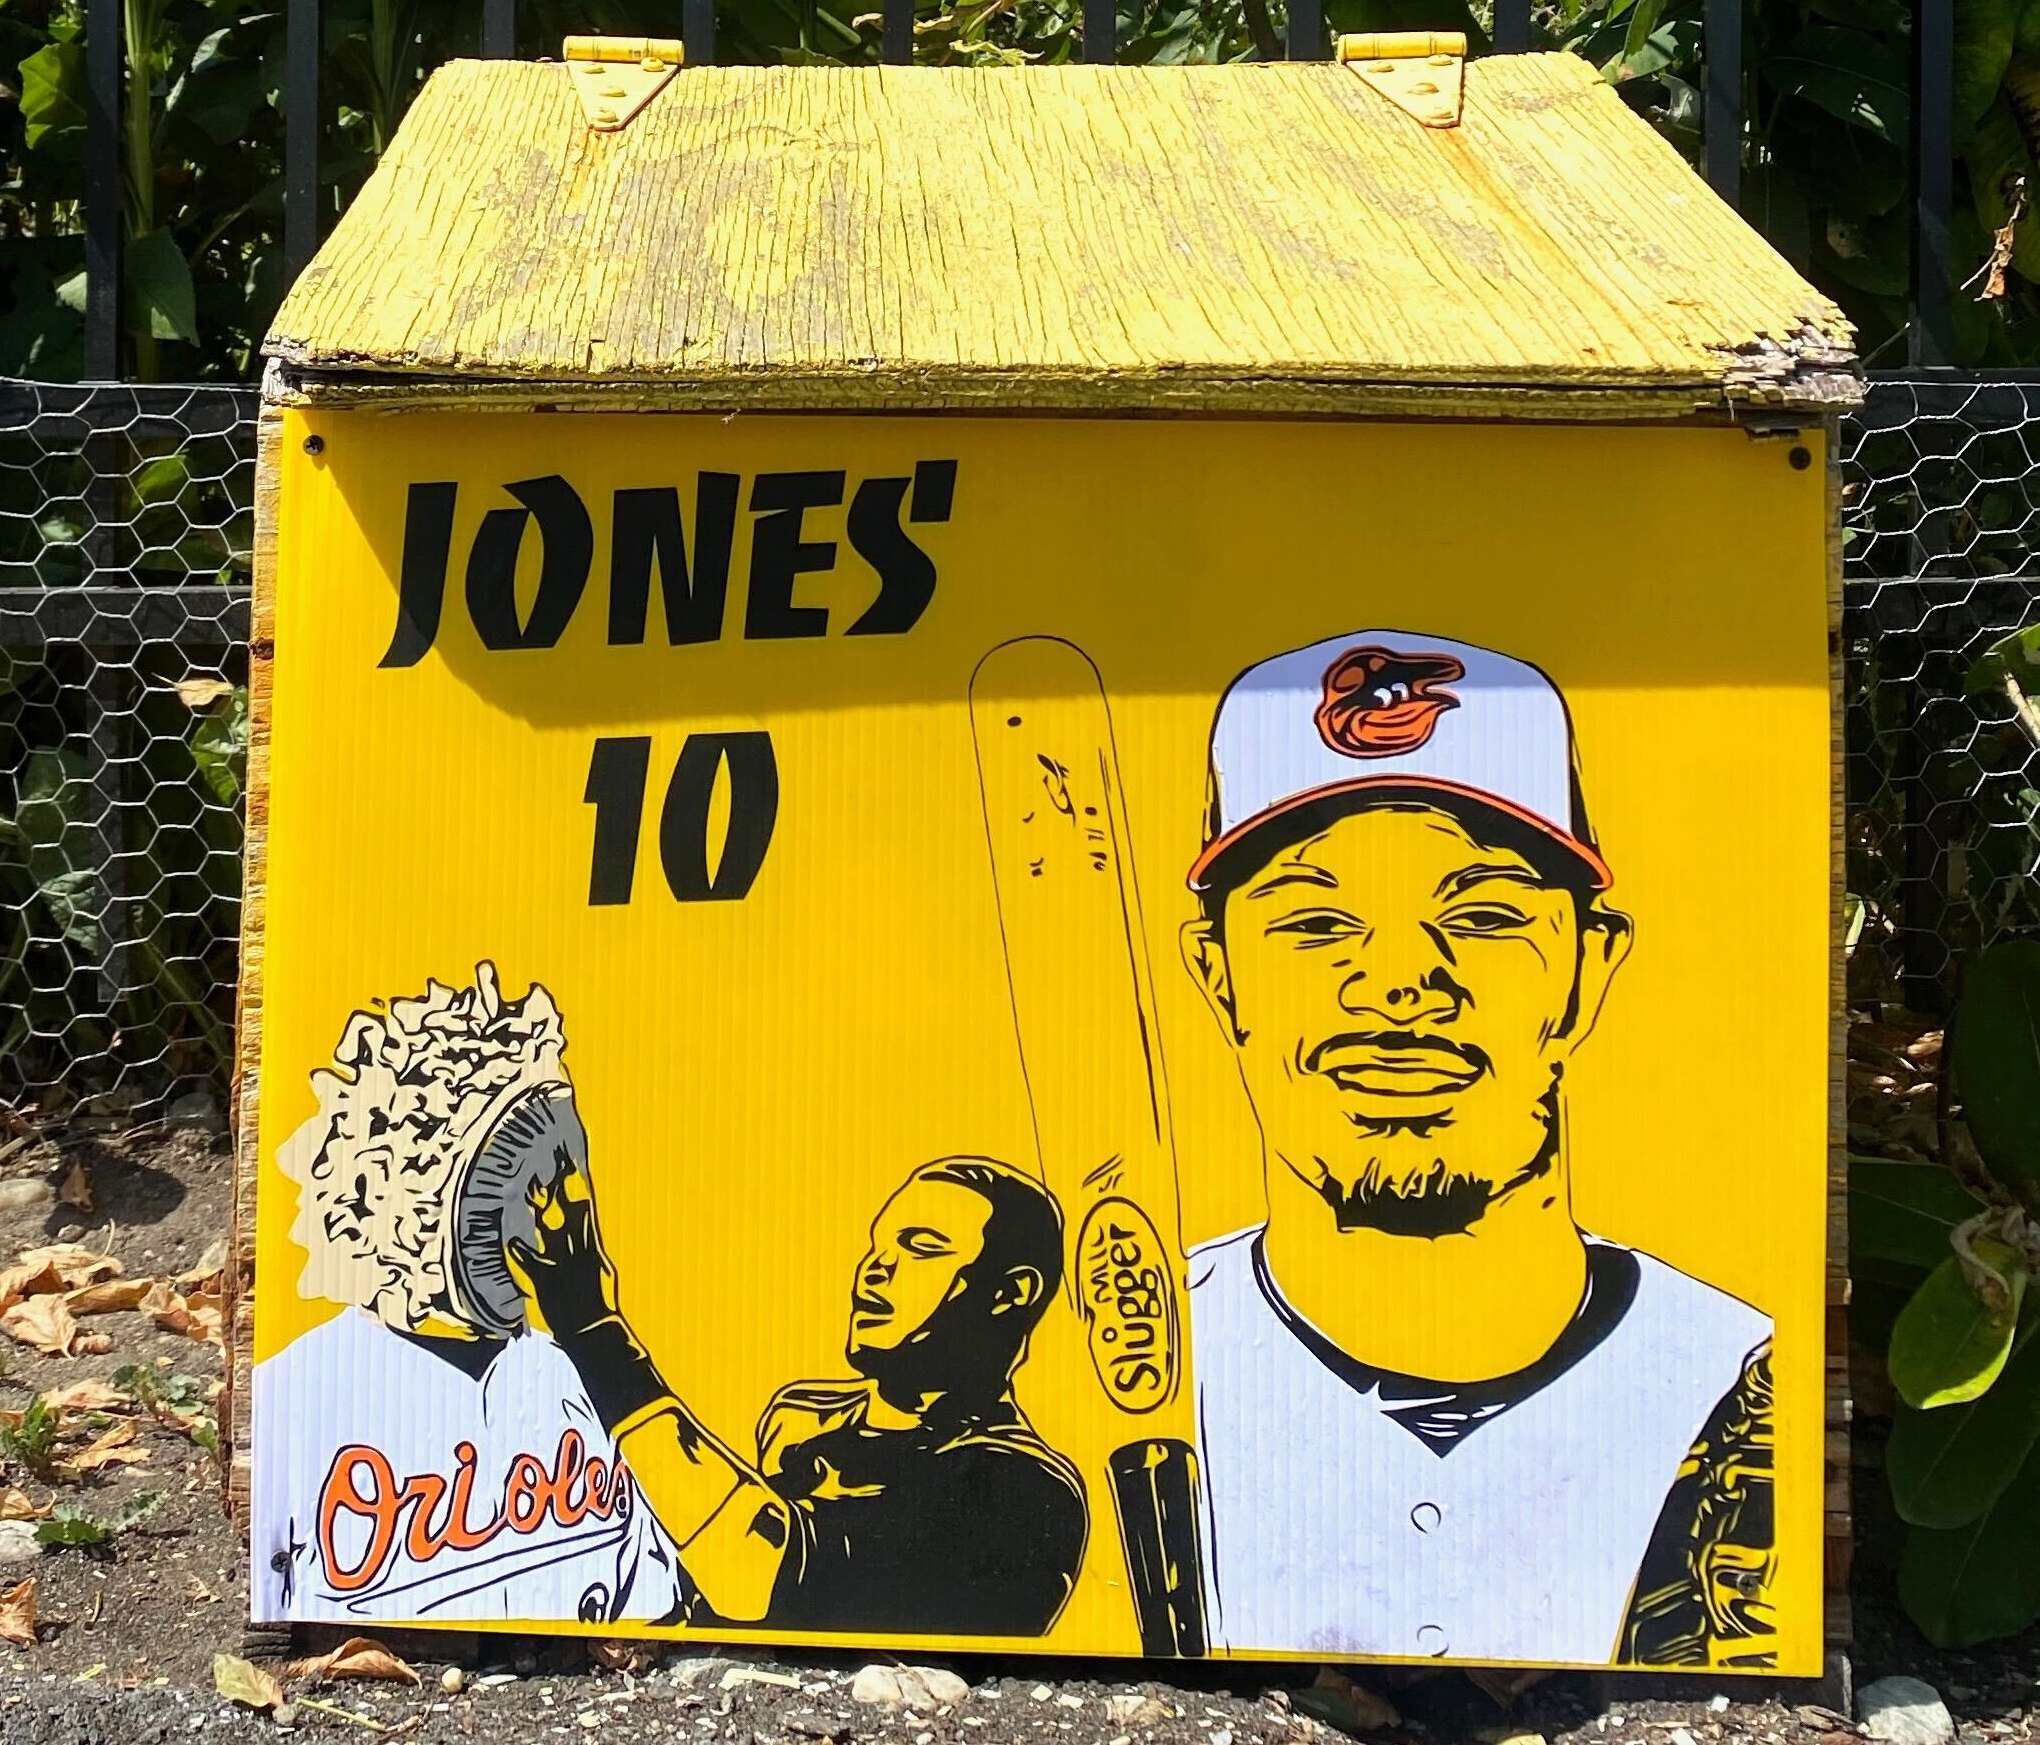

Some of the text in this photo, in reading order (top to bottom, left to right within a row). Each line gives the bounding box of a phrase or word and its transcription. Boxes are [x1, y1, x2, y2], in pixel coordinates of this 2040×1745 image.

[376, 459, 959, 668] JONES
[583, 731, 780, 906] 10
[1109, 1222, 1162, 1393] Slugger
[315, 1427, 634, 1591] Orioles
